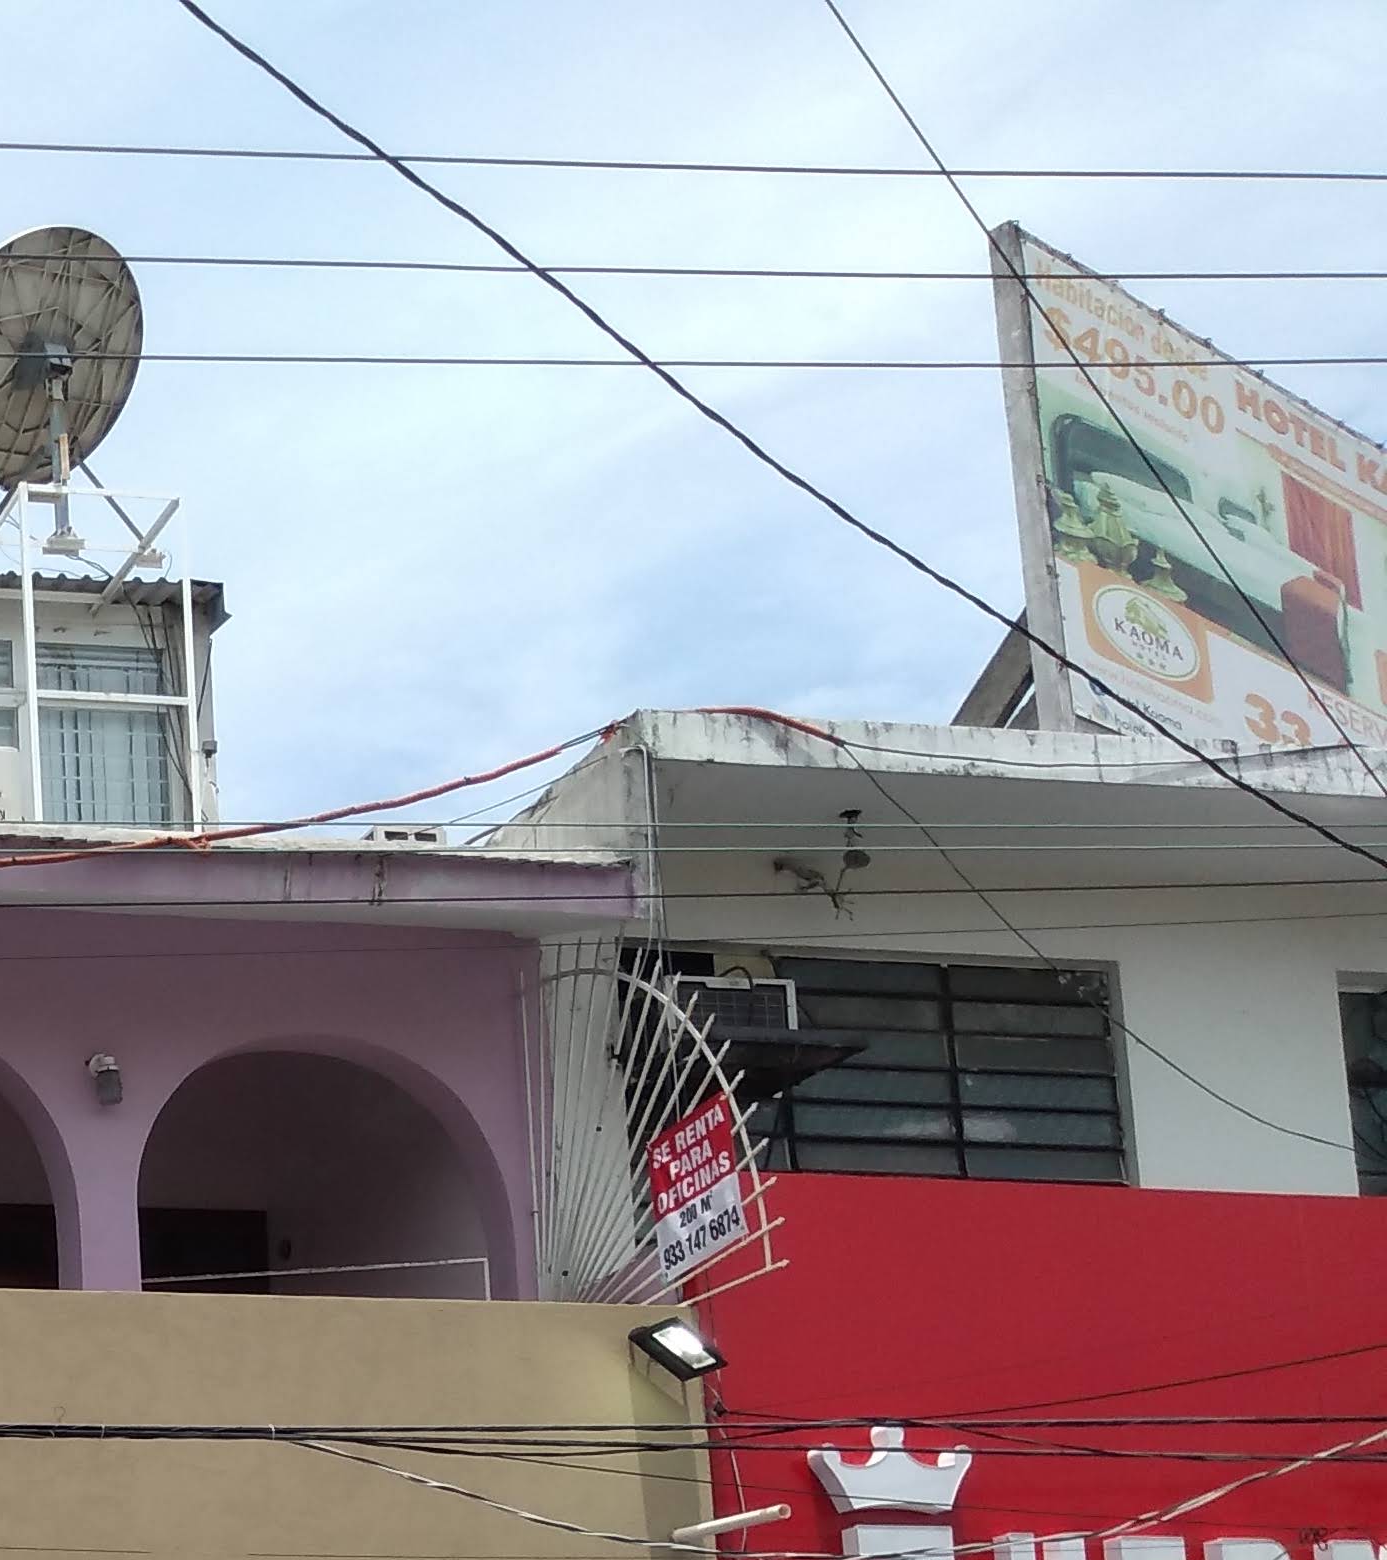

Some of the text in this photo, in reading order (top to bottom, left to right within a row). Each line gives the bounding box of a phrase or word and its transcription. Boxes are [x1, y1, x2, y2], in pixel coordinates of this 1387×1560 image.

[1235, 379, 1346, 473] HOTEL
[1114, 617, 1184, 661] KAOMA
[652, 1103, 725, 1169] SE RENTA
[669, 1139, 713, 1181] PARA
[657, 1151, 731, 1214] OFICINAS
[663, 1205, 741, 1271] 933 147 6874
[679, 1202, 698, 1229] 200
